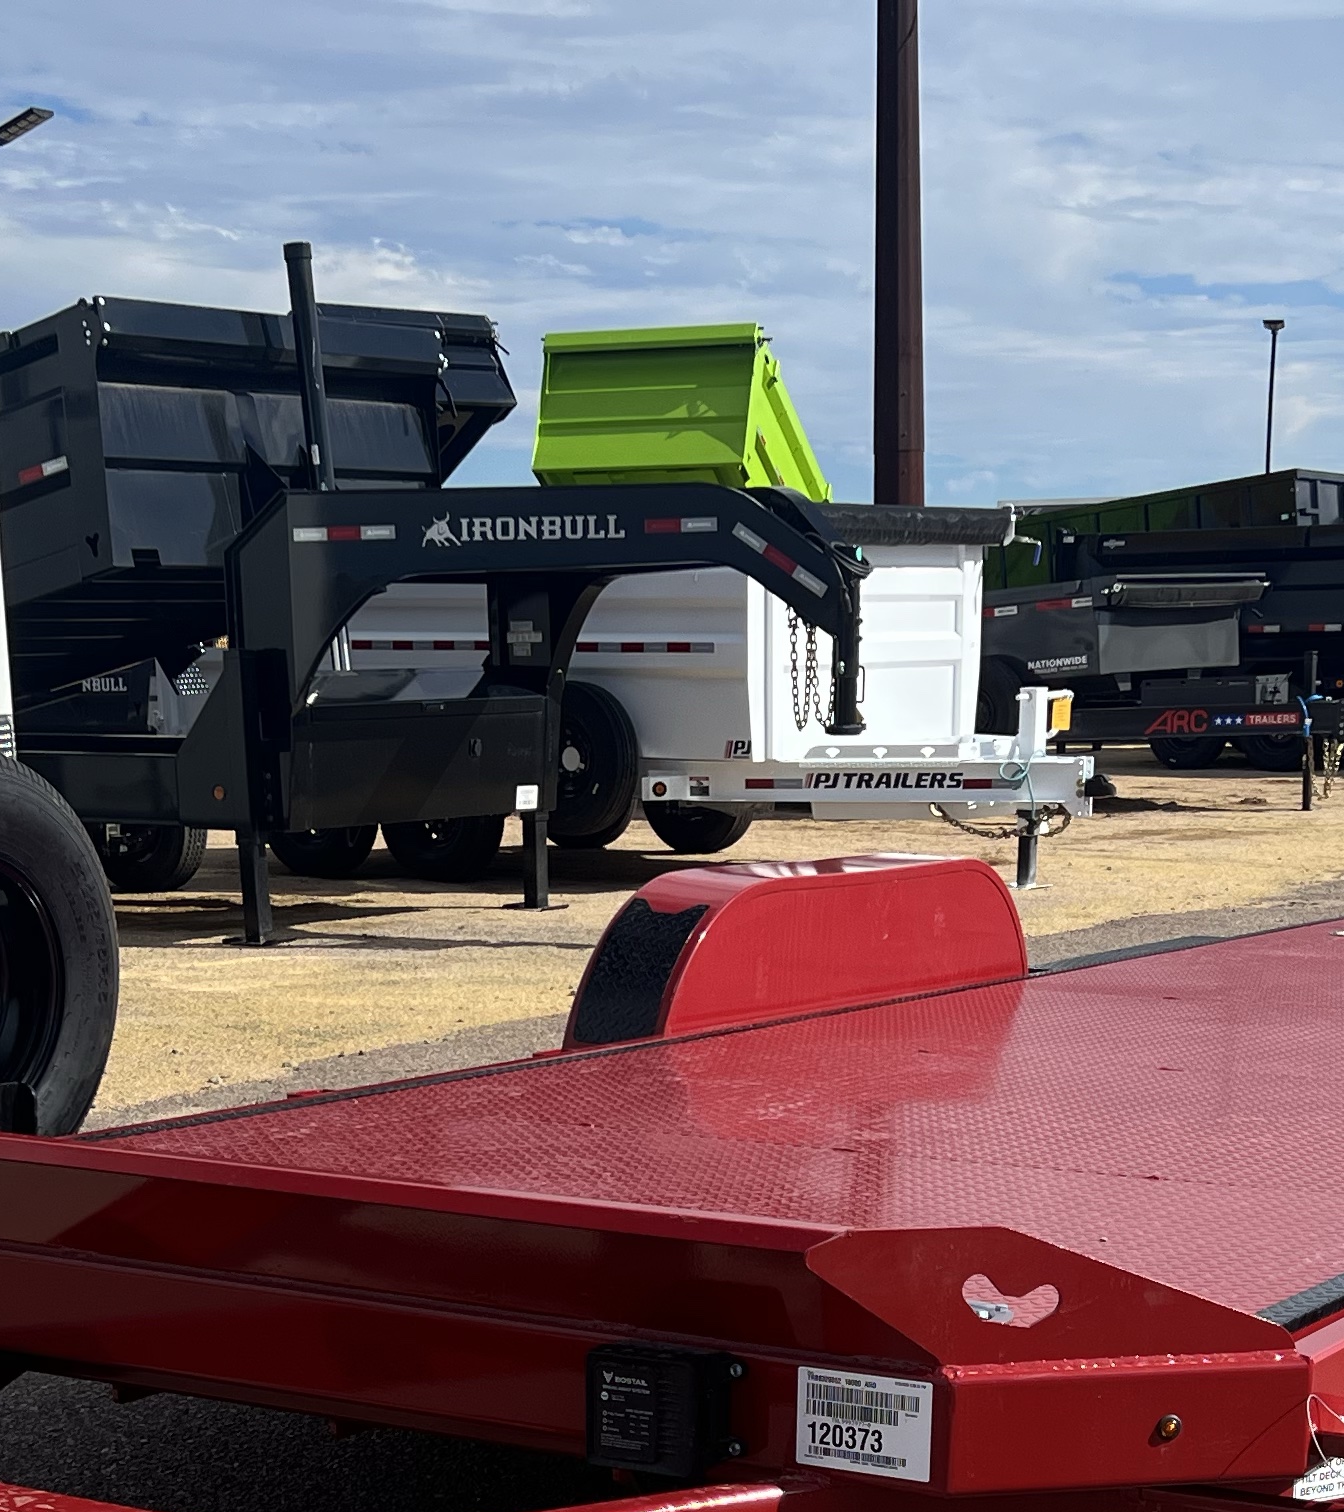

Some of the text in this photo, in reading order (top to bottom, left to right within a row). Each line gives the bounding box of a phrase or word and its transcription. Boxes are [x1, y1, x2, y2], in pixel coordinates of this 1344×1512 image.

[459, 514, 626, 541] IRONBULL
[1027, 654, 1088, 670] NATIONWIDE
[81, 677, 128, 692] NBULL
[1144, 709, 1209, 735] ARC
[1248, 714, 1297, 725] TRAILERS
[807, 1421, 883, 1453] 120373
[1319, 1470, 1341, 1481] DECK
[1300, 1483, 1335, 1497] BEYOND
